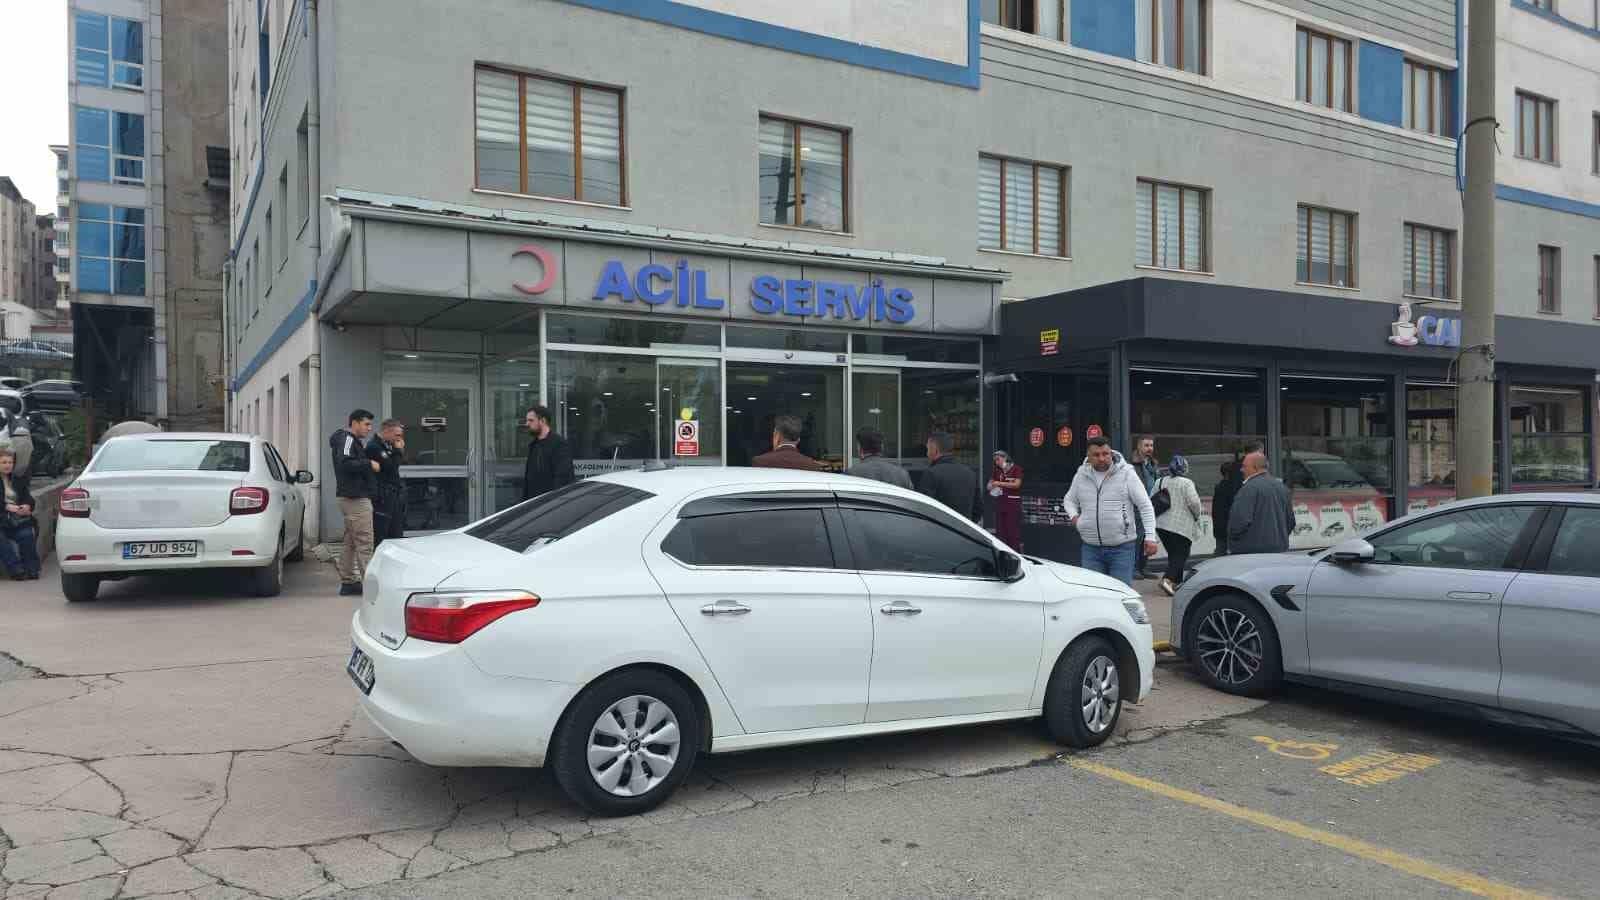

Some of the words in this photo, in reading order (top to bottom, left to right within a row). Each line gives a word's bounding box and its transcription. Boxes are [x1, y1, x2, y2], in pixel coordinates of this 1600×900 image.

[592, 257, 725, 310] ACİL
[751, 274, 915, 324] SERVİS
[131, 543, 145, 554] 67
[171, 543, 194, 553] 954
